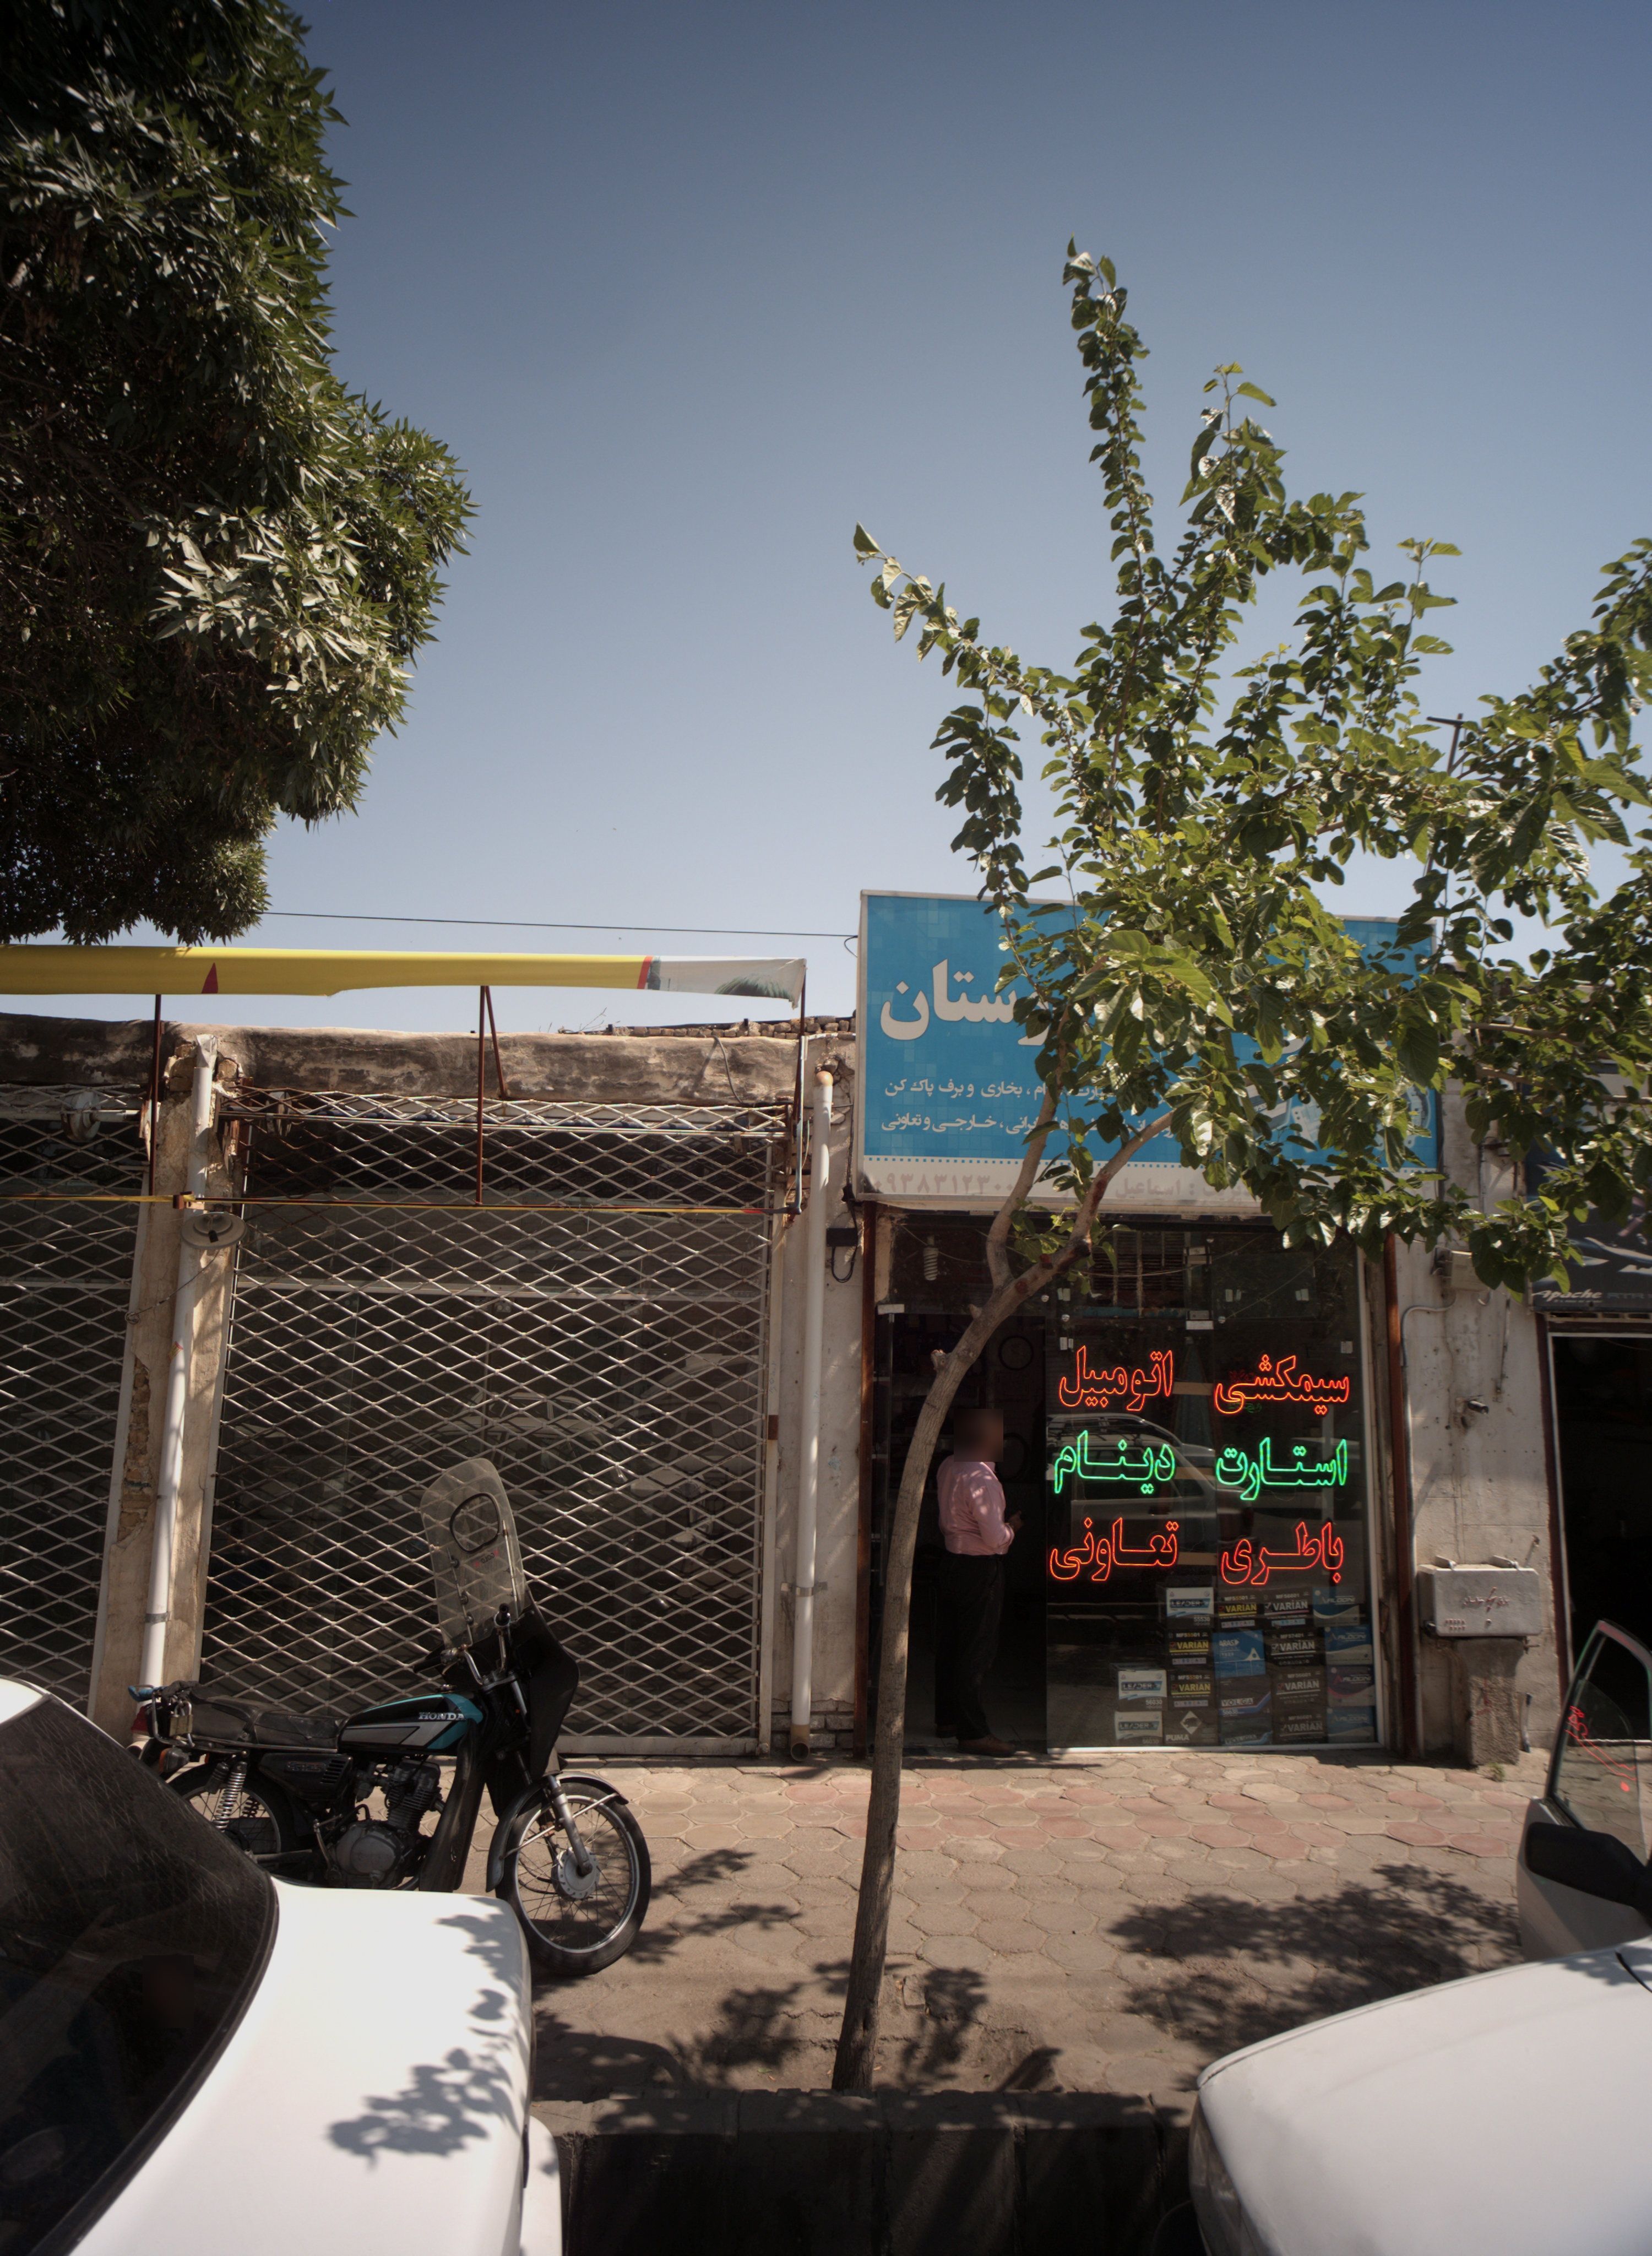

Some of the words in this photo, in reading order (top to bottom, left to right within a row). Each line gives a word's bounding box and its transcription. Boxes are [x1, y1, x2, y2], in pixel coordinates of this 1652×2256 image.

[938, 1079, 964, 1098] برف
[981, 1081, 1023, 1098] بخاری
[881, 1113, 922, 1131] تعاونی
[932, 1114, 997, 1132] خارجی
[874, 1173, 1017, 1194] ۰۹۳۸۳۱۲۳۰۰
[1116, 1178, 1180, 1199] اسماعیل
[1531, 1289, 1603, 1303] Apache
[1058, 1345, 1173, 1412] اتومبیل
[1214, 1354, 1349, 1415] سیمکشی
[1054, 1430, 1175, 1494] دینام
[1215, 1436, 1347, 1501] استارت
[1049, 1516, 1179, 1581] تعاونی
[1220, 1521, 1344, 1585] باطری
[419, 1712, 465, 1721] HONDA
